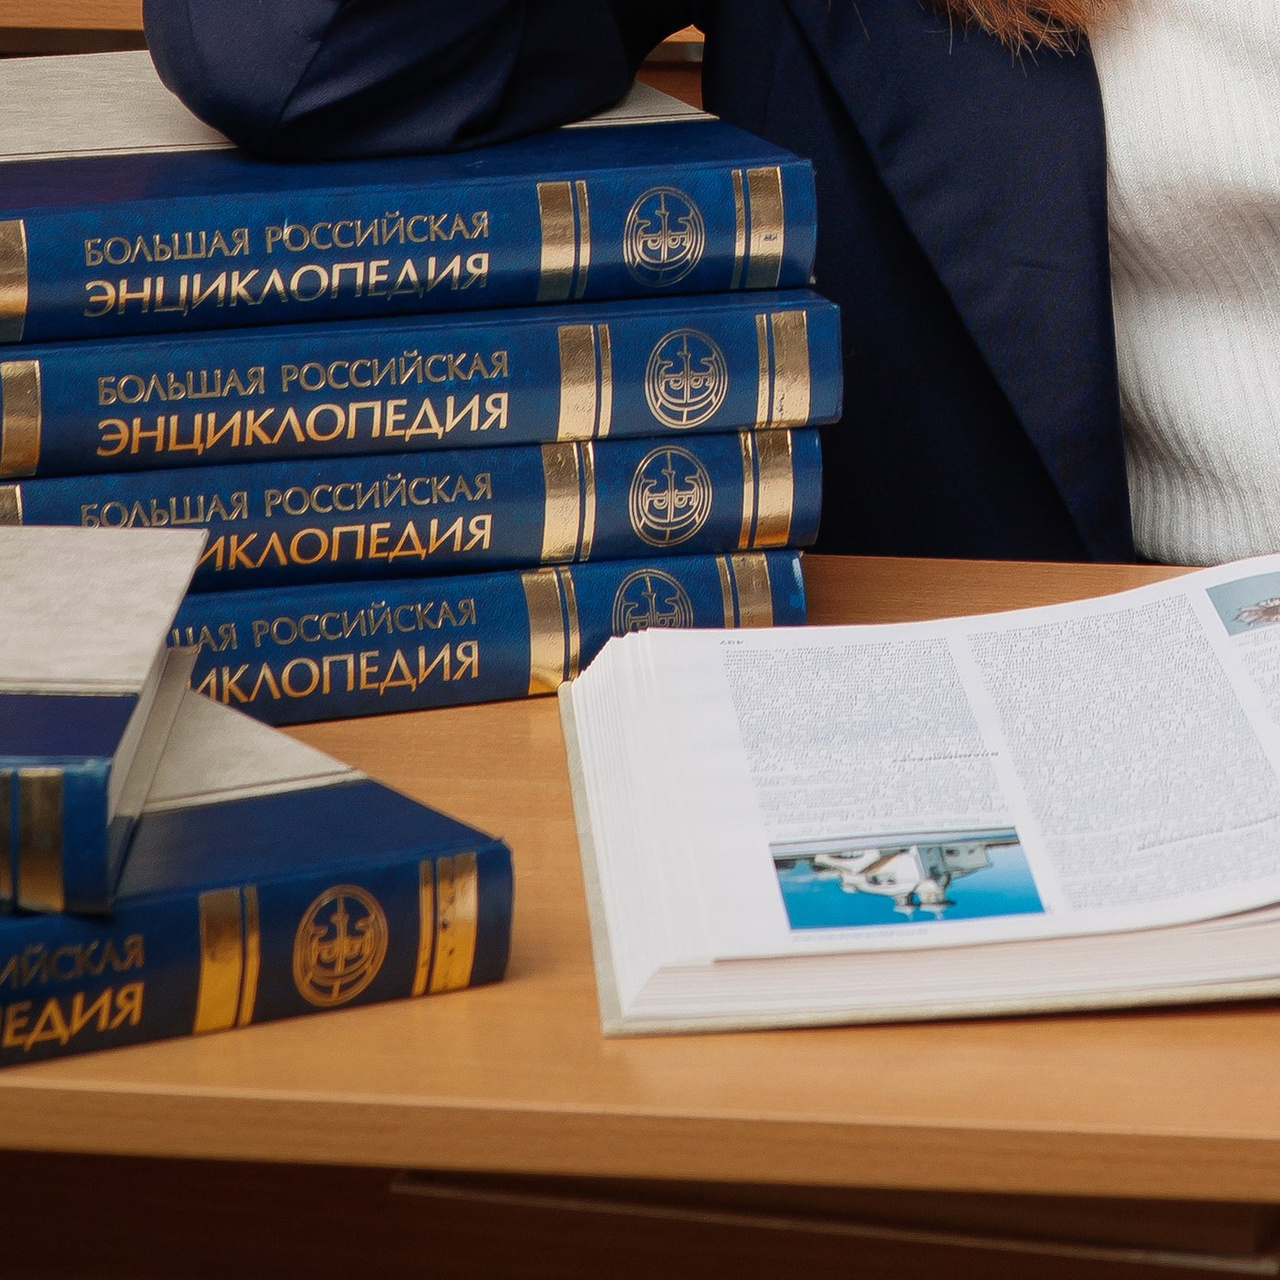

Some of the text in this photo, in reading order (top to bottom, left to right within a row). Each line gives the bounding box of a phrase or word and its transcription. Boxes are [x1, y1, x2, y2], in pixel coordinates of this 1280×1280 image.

[83, 210, 490, 267] БОЛЬШАЯ РОССИЙСКАЯ
[83, 252, 491, 318] ЭНЦИКЛОПЕДИЯ
[97, 349, 509, 406] БОЛЬШАЯ РОССИЙСКАЯ
[96, 392, 510, 457] ЭНЦИКЛОПЕДИЯ
[80, 472, 493, 529] БОЛЬШАЯ РОССИЙСКАЯ
[195, 514, 493, 572] ИКЛОПЕДИЯ
[252, 598, 478, 648] РОССИЙСКАЯ
[187, 640, 479, 705] ИКЛОПЕДИЯ
[0, 933, 146, 989] ИЙСКАЯ
[0, 981, 146, 1053] ЕДИЯ
